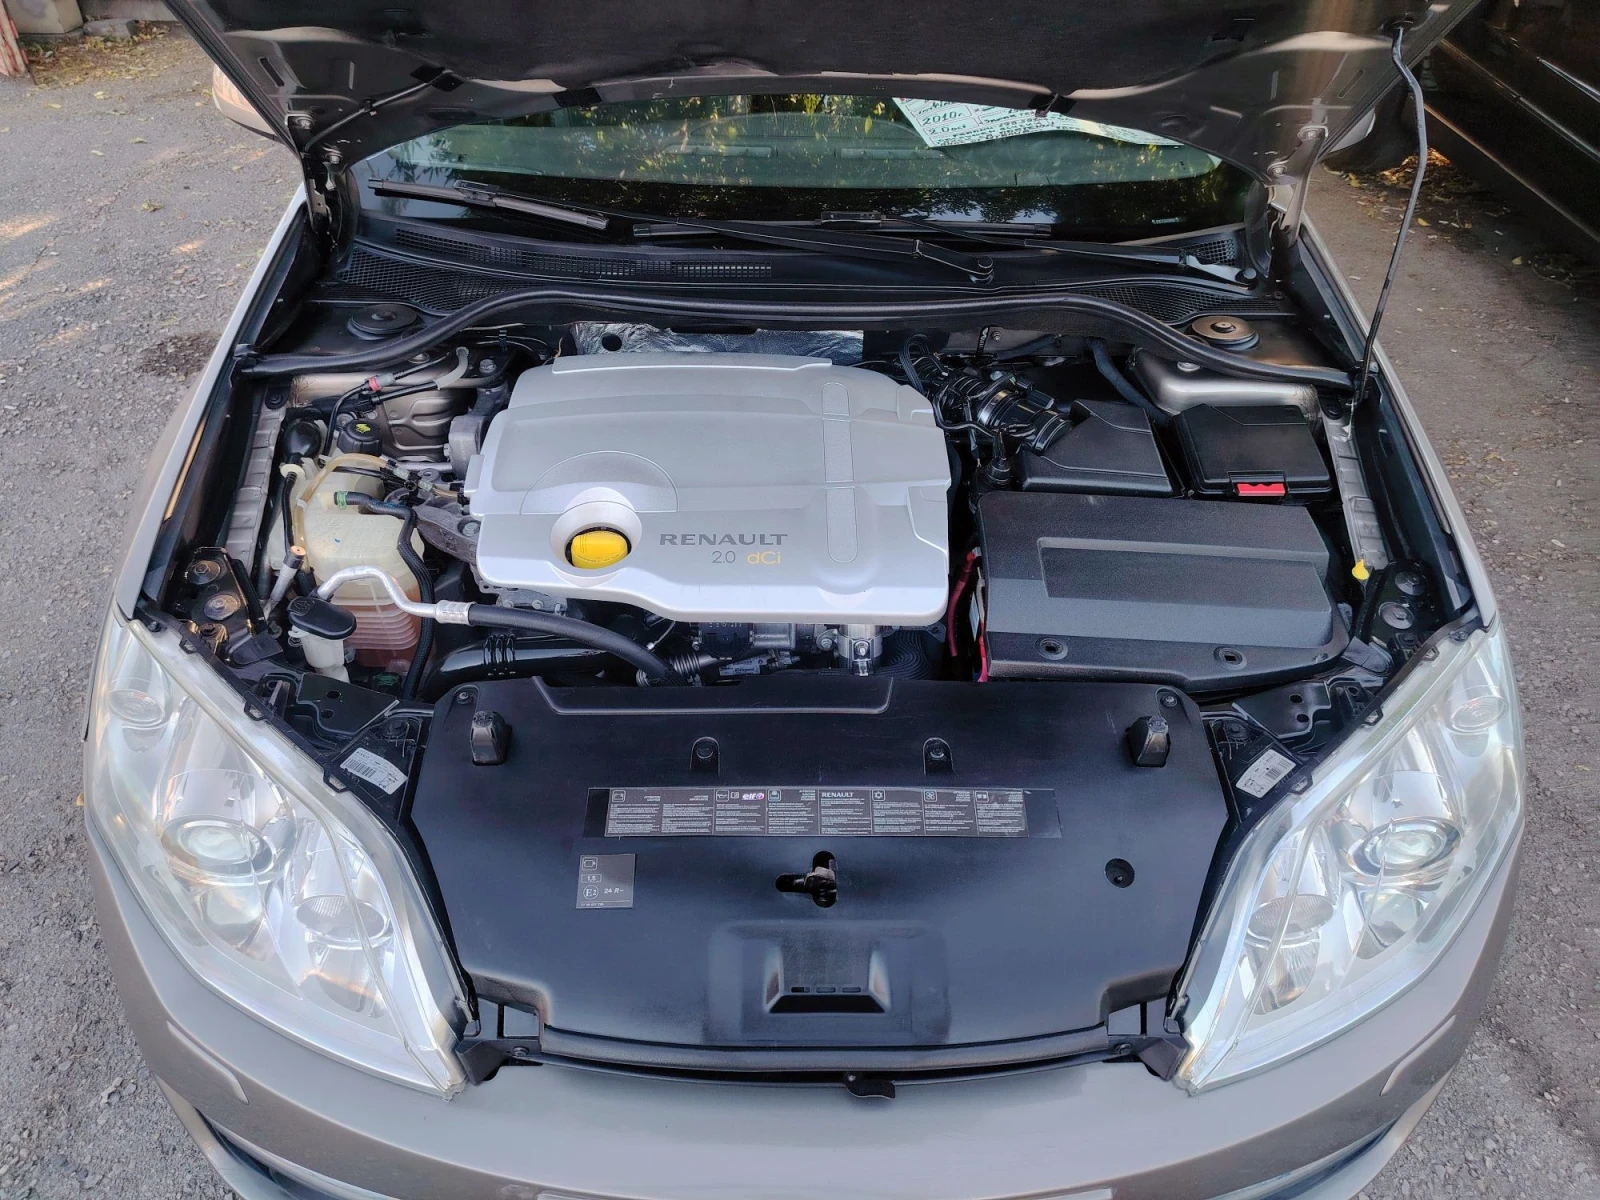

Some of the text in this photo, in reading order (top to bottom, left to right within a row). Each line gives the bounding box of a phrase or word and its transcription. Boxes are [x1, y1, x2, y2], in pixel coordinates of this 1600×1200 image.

[659, 533, 788, 546] RENAULT
[711, 550, 781, 564] 2.0 dCi
